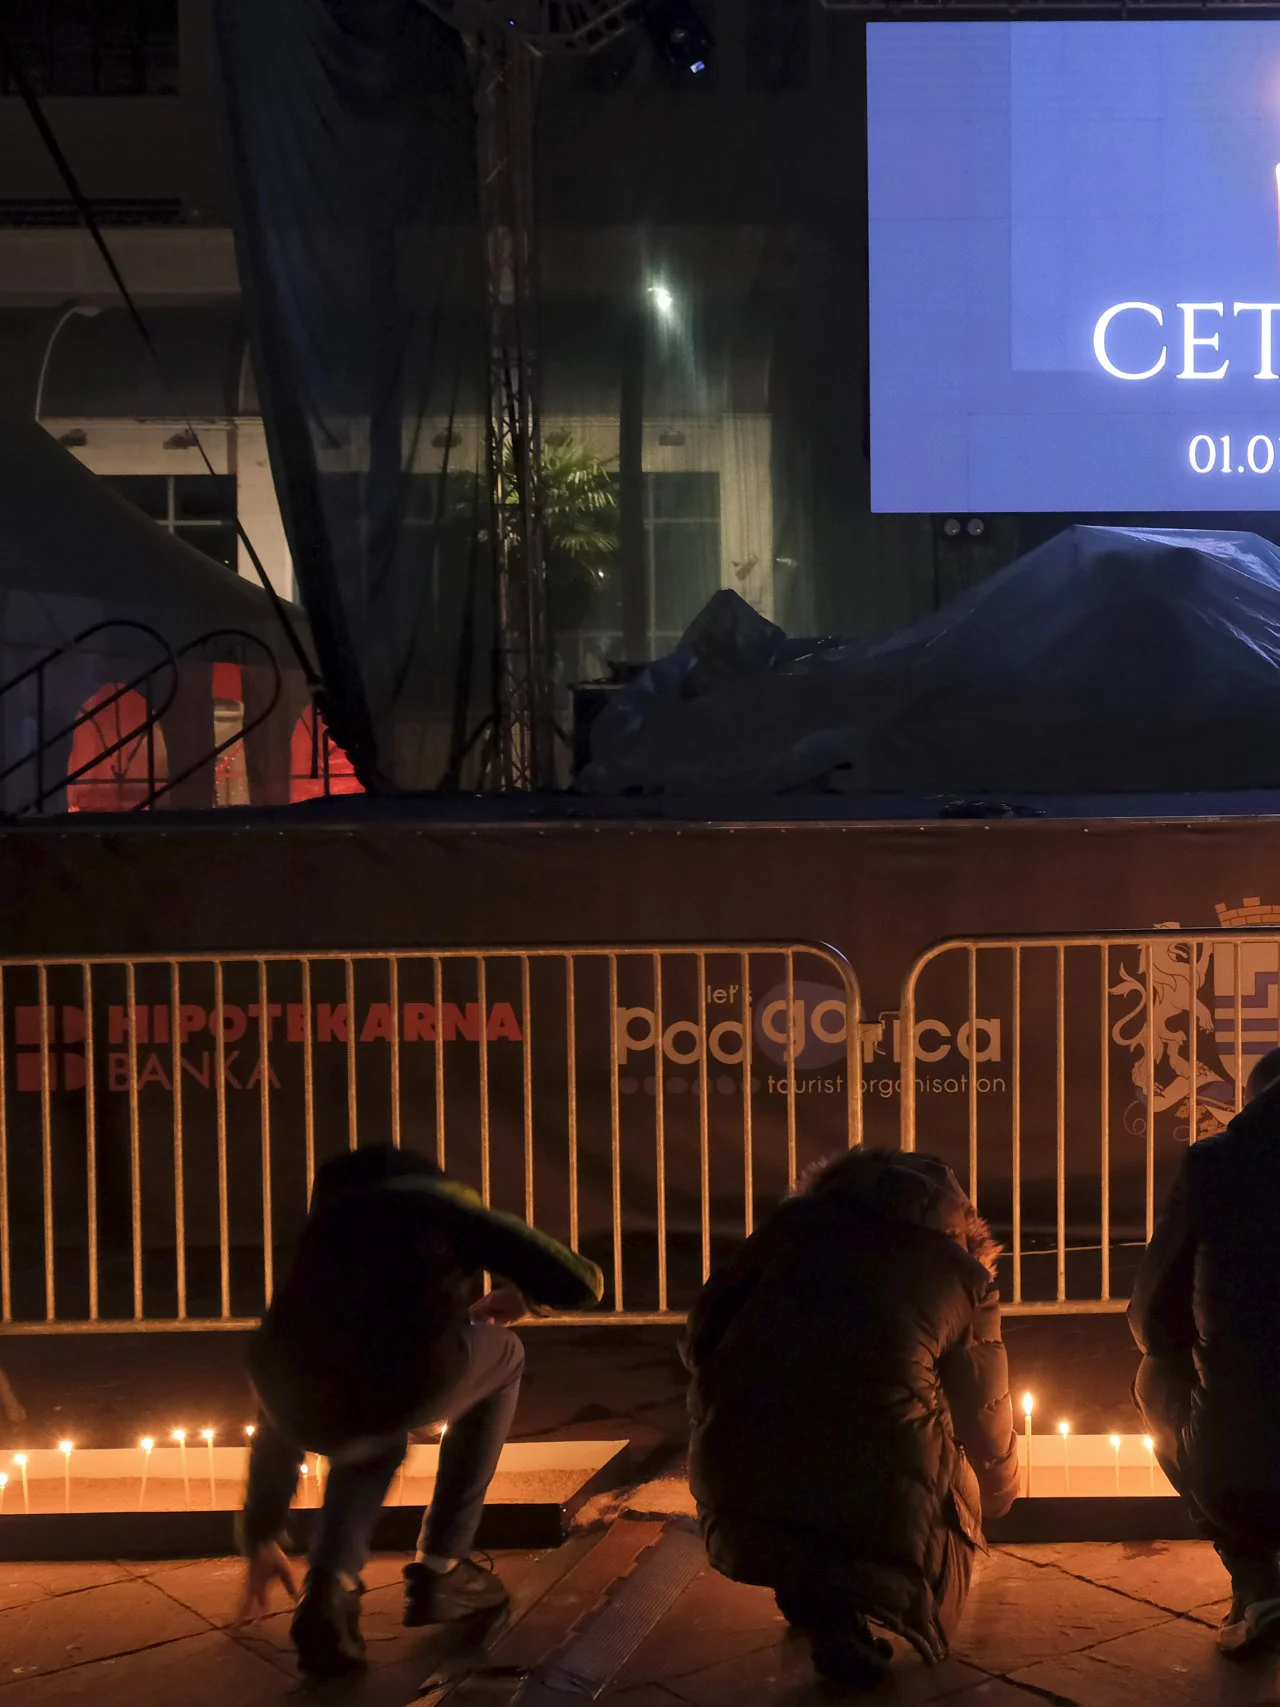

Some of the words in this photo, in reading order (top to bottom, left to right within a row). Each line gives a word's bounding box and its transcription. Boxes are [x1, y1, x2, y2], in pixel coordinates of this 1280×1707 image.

[107, 1002, 524, 1044] HIPOTEKARNA
[107, 1050, 282, 1092] BANKA
[767, 1074, 844, 1094] tourist
[861, 1074, 1006, 1098] rgnisaton
